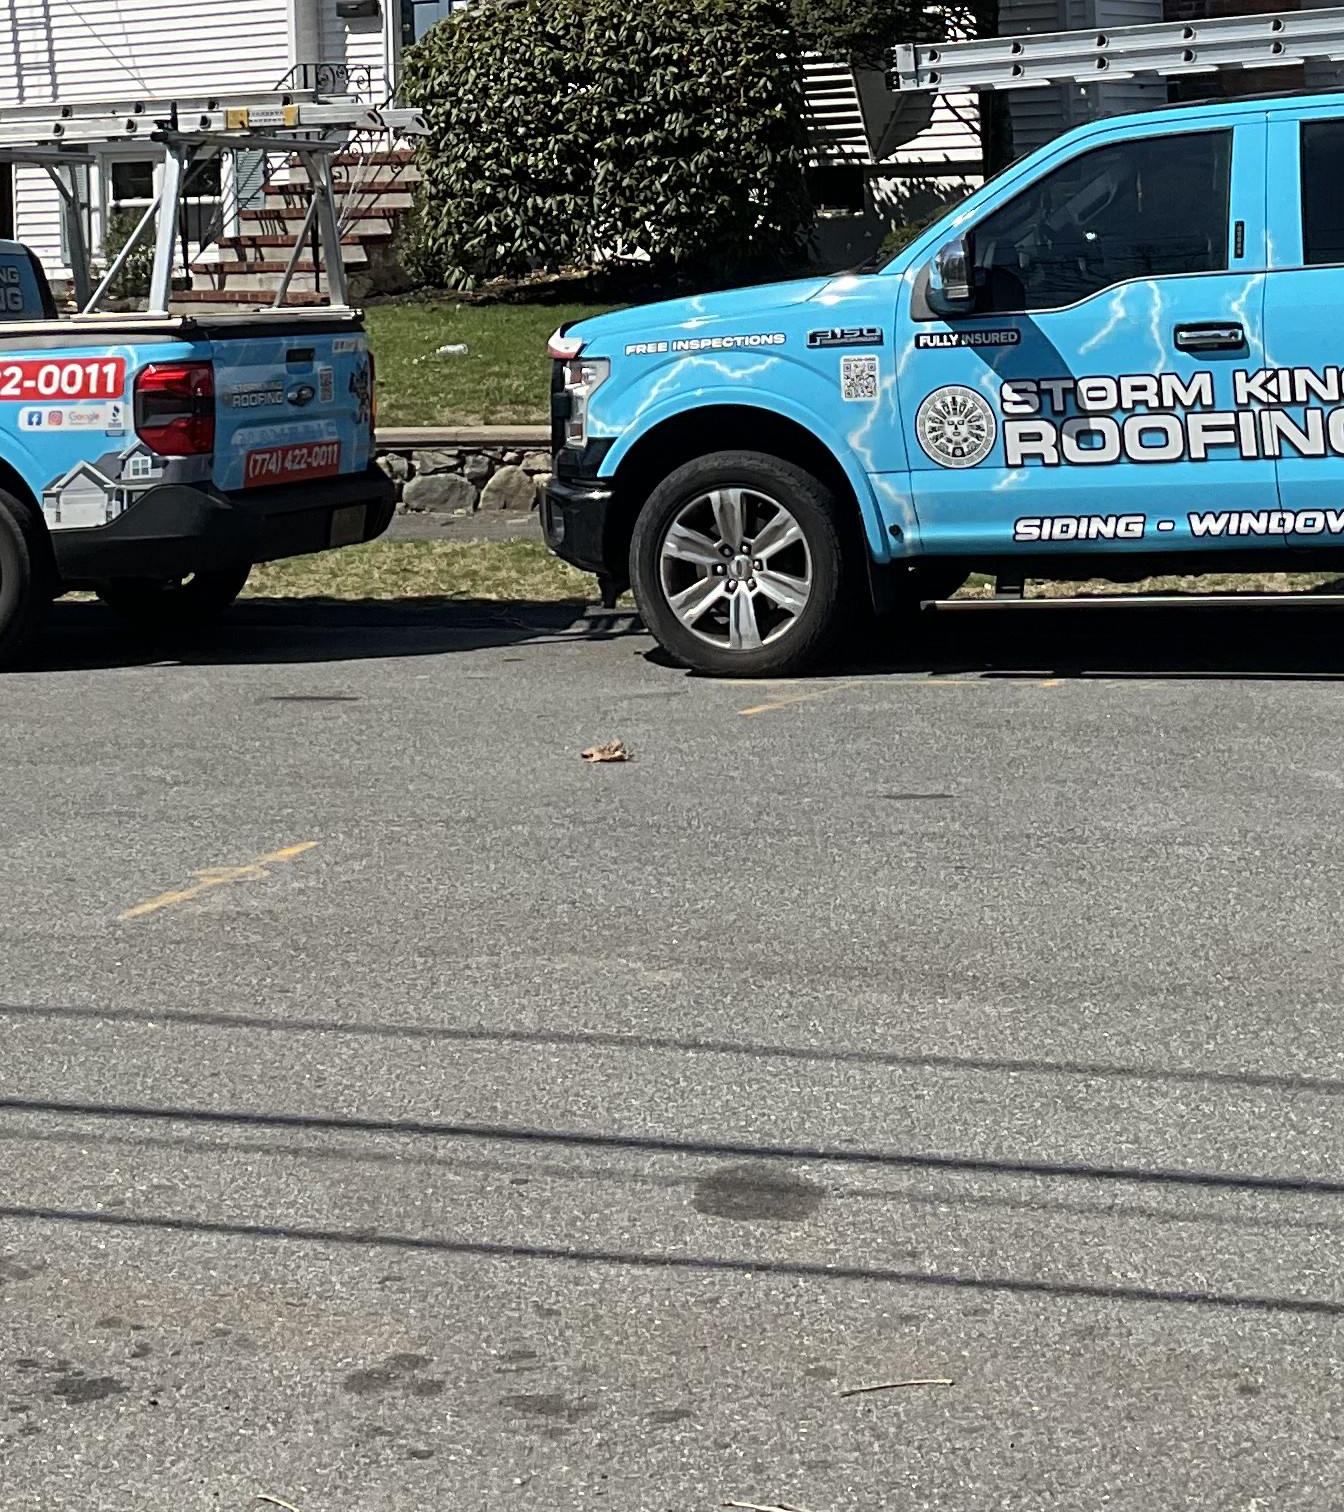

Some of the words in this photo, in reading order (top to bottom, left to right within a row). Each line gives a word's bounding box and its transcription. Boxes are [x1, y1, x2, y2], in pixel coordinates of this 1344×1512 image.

[625, 342, 668, 356] FREE
[672, 332, 786, 351] INSPECTIONS
[919, 334, 959, 347] FULLY
[960, 331, 1018, 345] INSURED
[232, 391, 284, 408] ROOFING
[1001, 372, 1213, 414] STORM
[249, 449, 282, 478] (774)
[284, 443, 339, 471] 422-0011
[1013, 514, 1146, 541] SIDING
